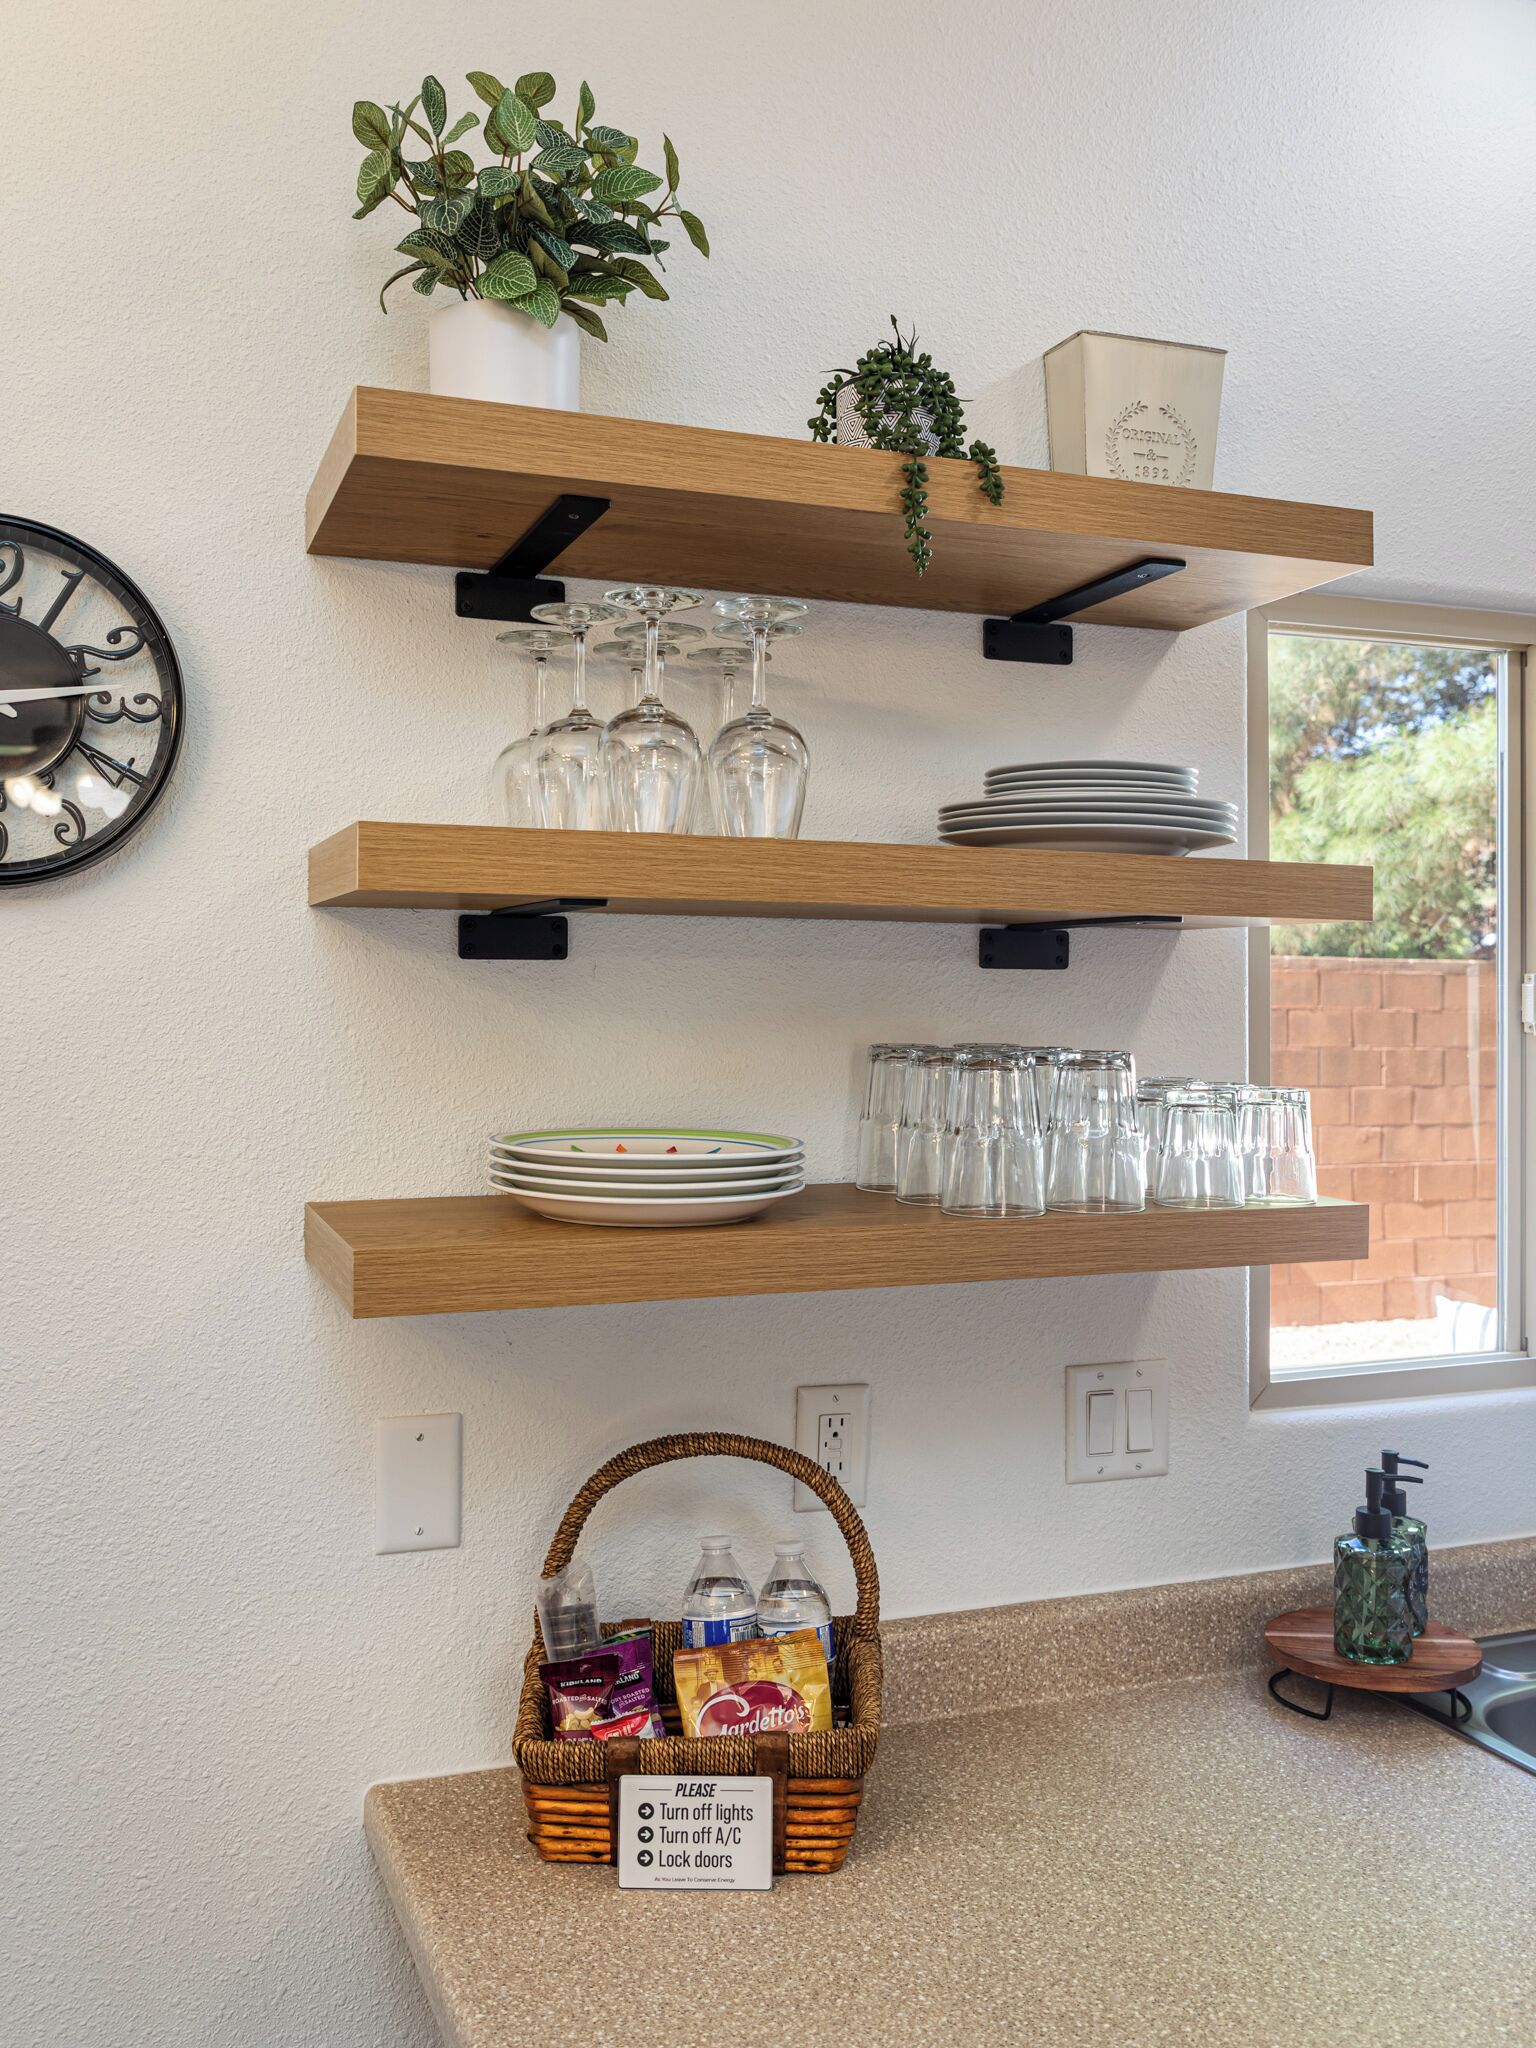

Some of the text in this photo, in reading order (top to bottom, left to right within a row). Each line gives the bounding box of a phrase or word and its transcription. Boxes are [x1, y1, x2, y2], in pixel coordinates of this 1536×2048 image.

[1121, 427, 1182, 447] ORIGINAL
[1145, 448, 1157, 462] &
[0, 540, 24, 616] 2
[39, 569, 85, 634] 1
[66, 626, 147, 678] 2
[85, 691, 163, 724] 3
[75, 738, 152, 790] 4
[623, 1687, 650, 1700] ROASTED
[674, 1783, 717, 1798] PLEASE
[659, 1802, 754, 1824] Turn off lights
[659, 1826, 742, 1847] Turn off A/C
[658, 1850, 733, 1868] Lock doors
